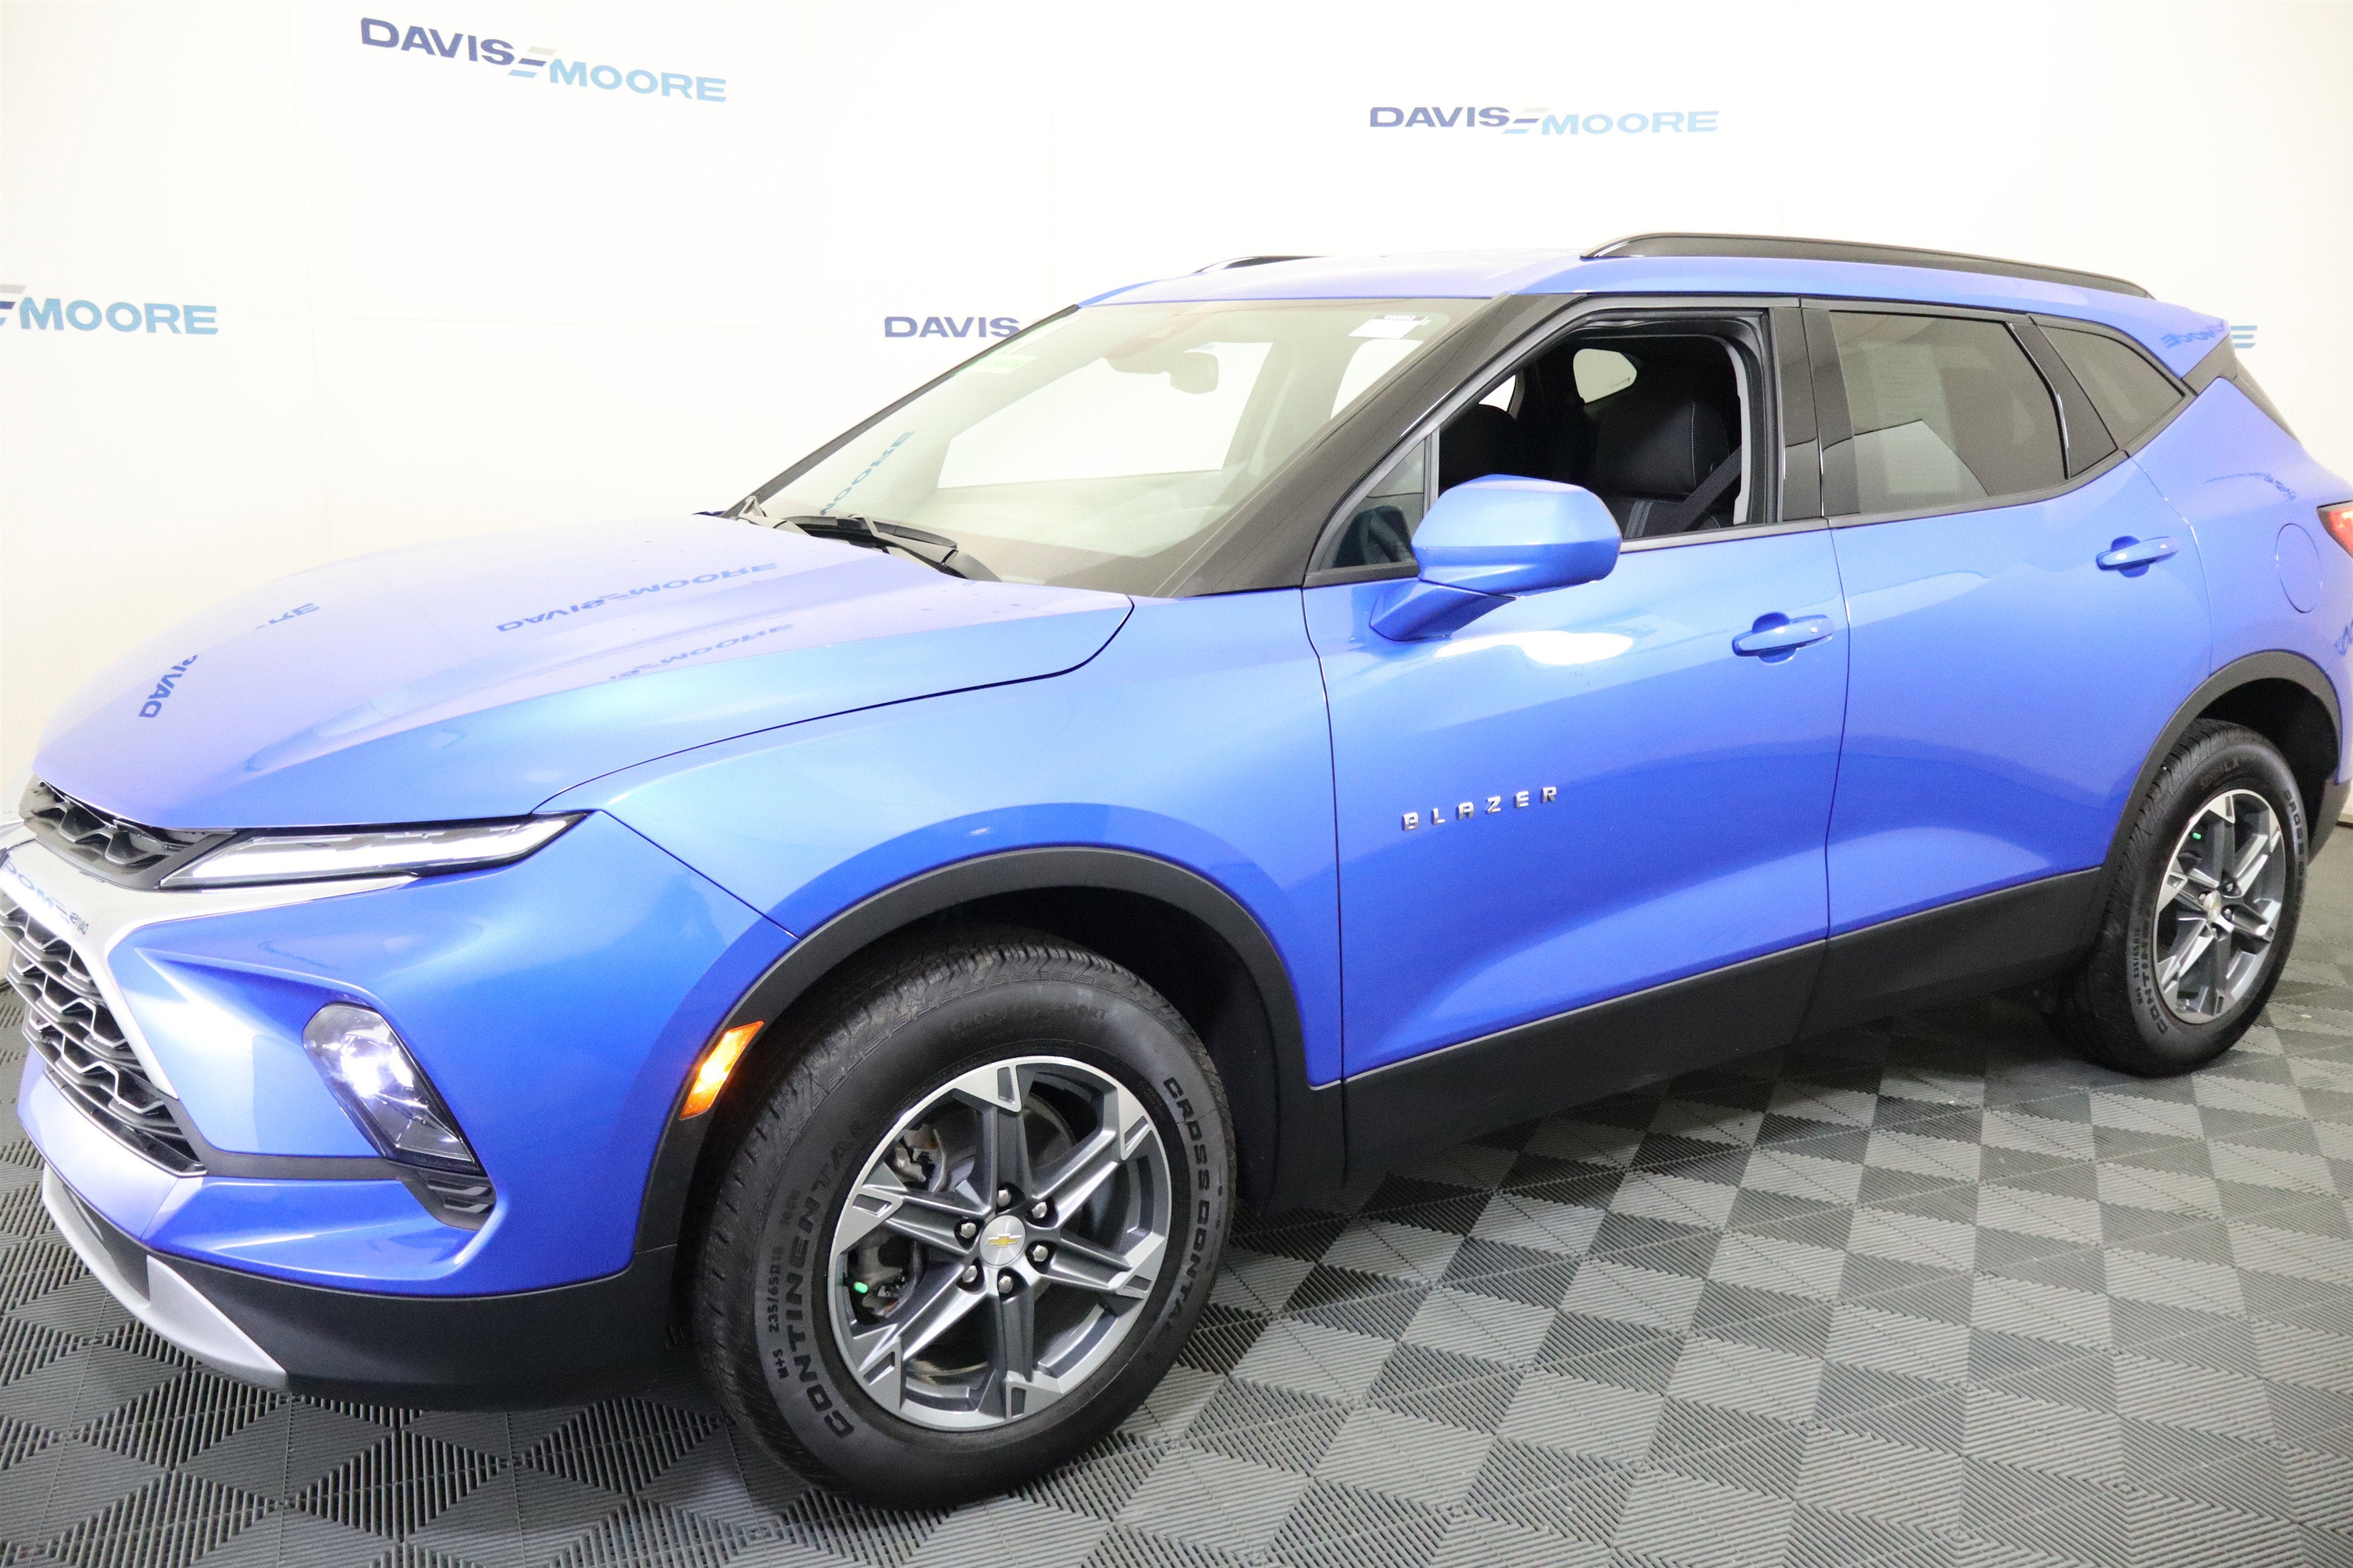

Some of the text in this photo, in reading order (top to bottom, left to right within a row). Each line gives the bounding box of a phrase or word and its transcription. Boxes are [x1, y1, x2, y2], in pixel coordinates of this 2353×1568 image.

[360, 17, 727, 103] DAVIS MOORE
[1370, 106, 1719, 135] DAVIS MOORE
[19, 296, 219, 335] MOORE
[884, 316, 1020, 338] DAVIS
[1401, 786, 1557, 832] BLAZER
[1163, 1076, 1210, 1191] CROSS
[786, 1115, 866, 1439] CONTINENTAL
[773, 1348, 790, 1380] M+S
